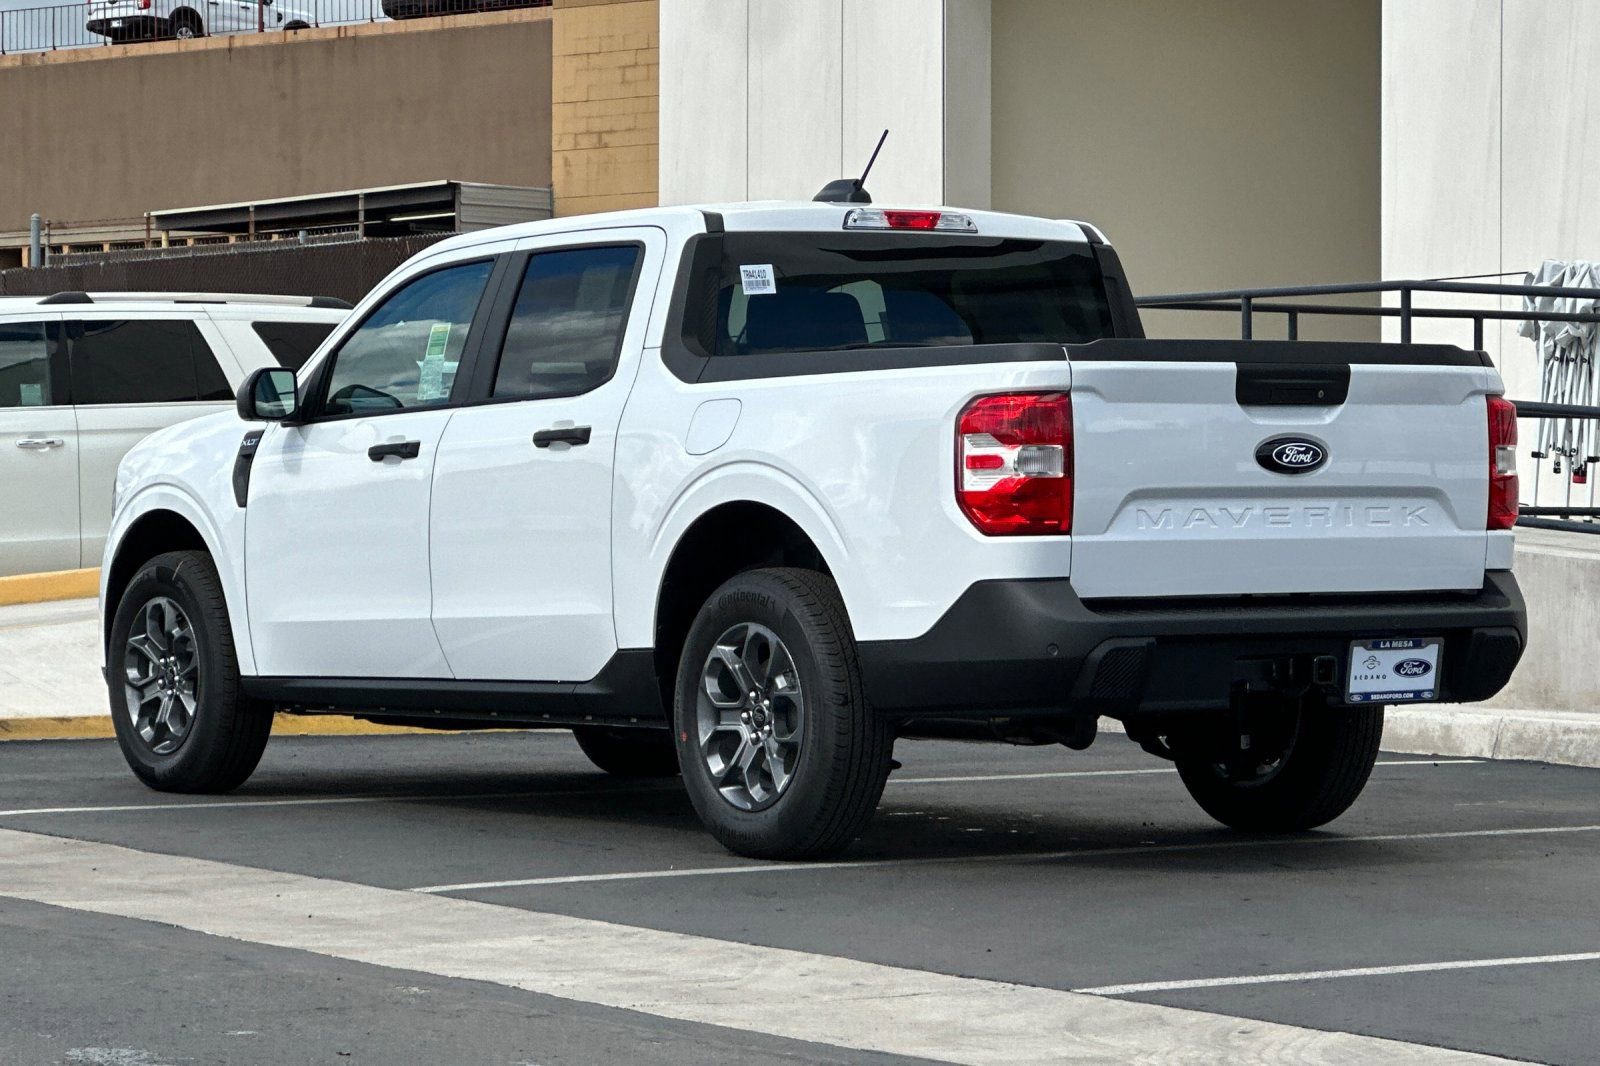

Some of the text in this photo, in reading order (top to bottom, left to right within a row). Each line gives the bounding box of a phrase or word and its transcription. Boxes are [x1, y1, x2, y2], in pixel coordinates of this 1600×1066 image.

[241, 438, 259, 446] XLT
[1282, 446, 1313, 463] Ford
[1136, 506, 1430, 529] MAVERICK
[1392, 640, 1413, 648] MESA
[1400, 661, 1425, 674] Ford
